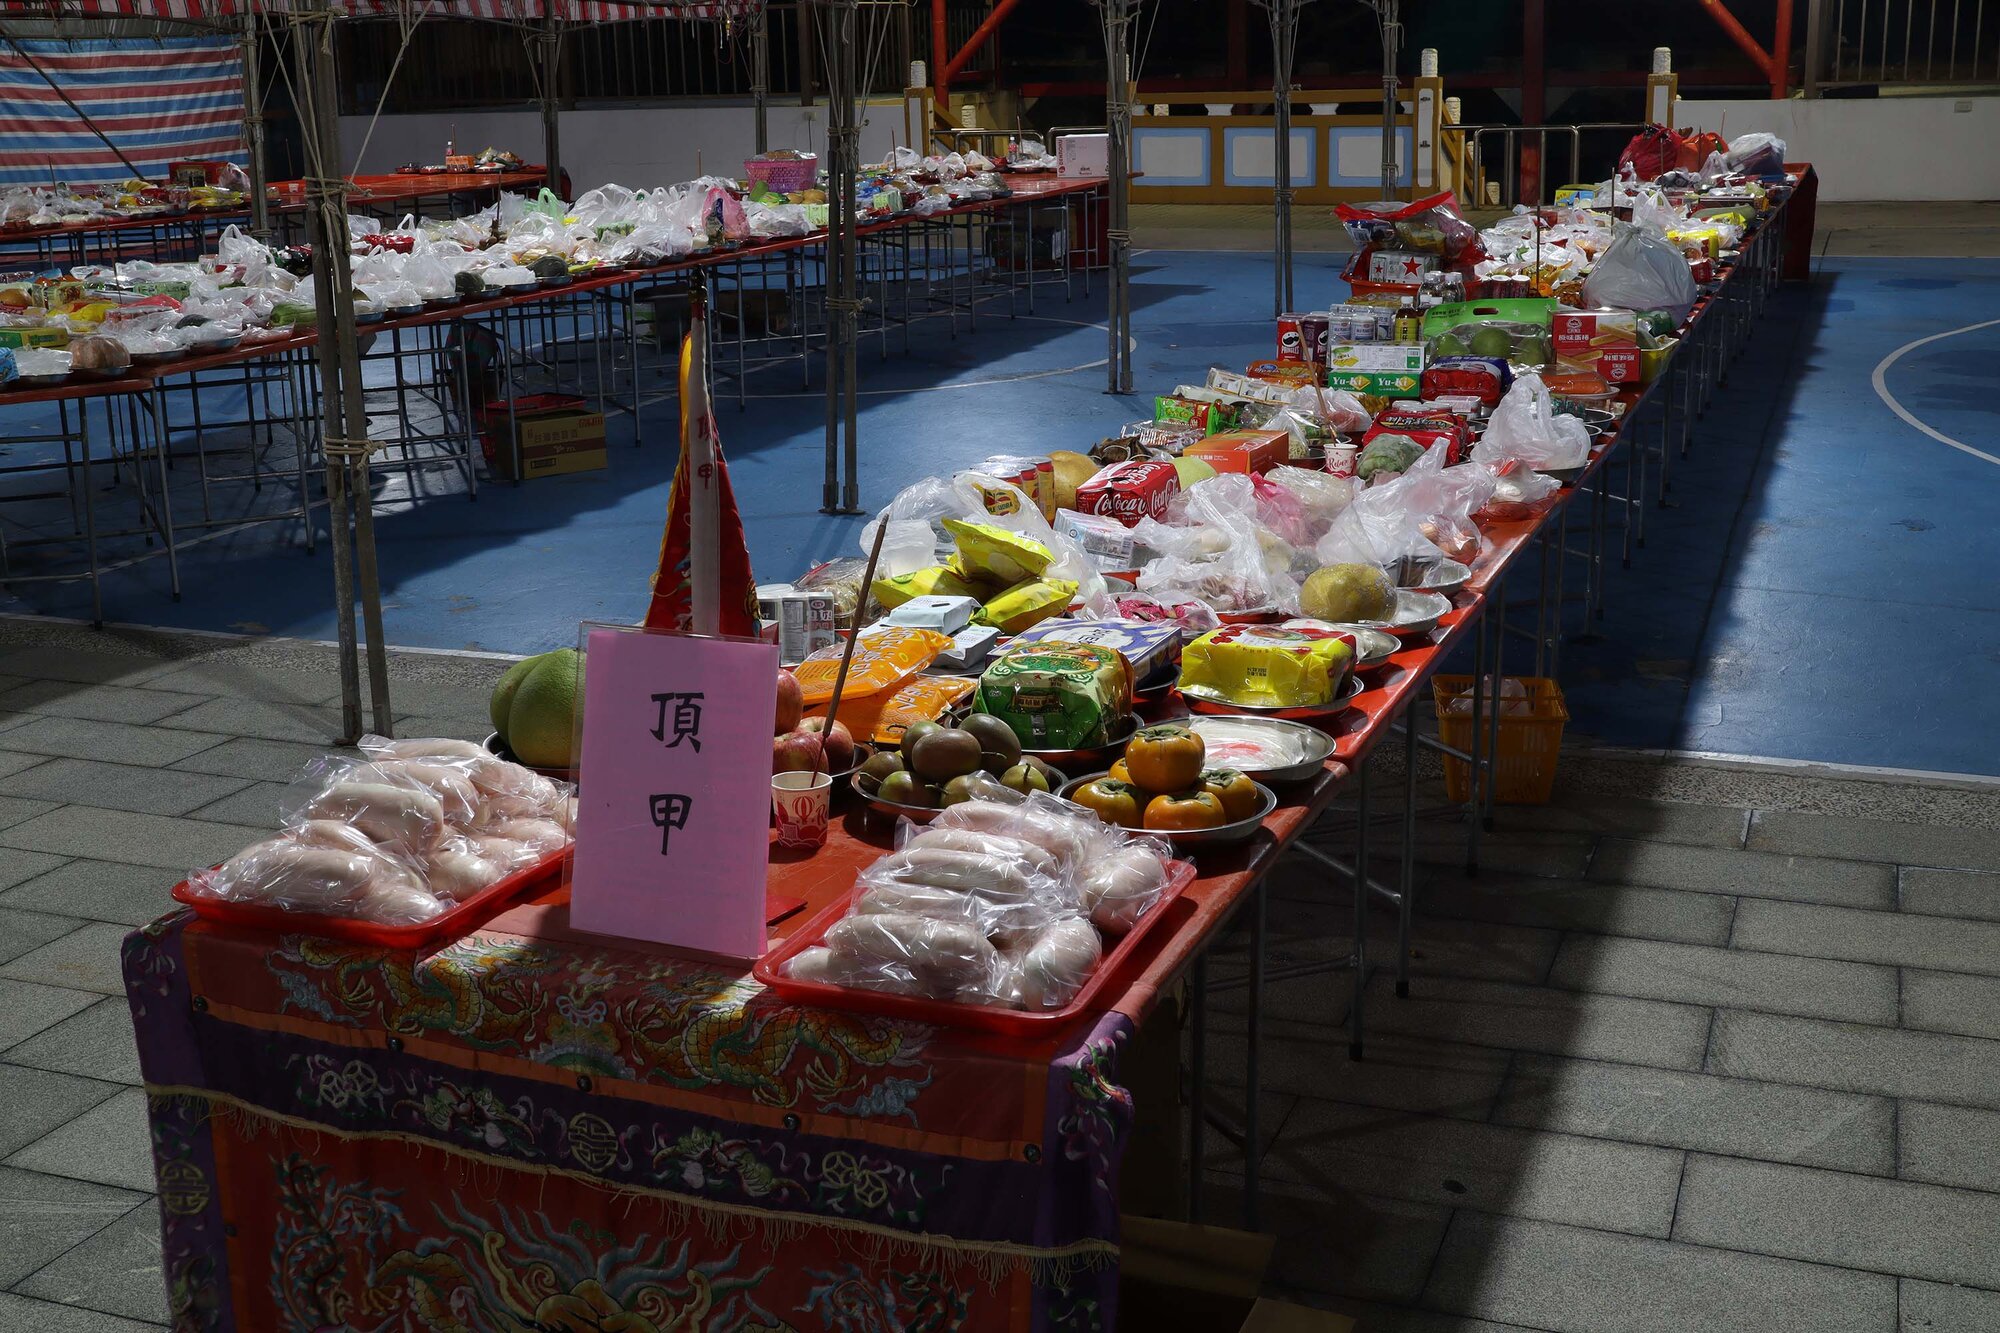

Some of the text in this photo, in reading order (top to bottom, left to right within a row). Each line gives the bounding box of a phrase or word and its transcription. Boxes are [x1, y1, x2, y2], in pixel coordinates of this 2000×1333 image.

[1332, 376, 1363, 387] Yu-Ki
[1377, 377, 1408, 388] Yu-Ki
[648, 691, 705, 856] 頂甲
